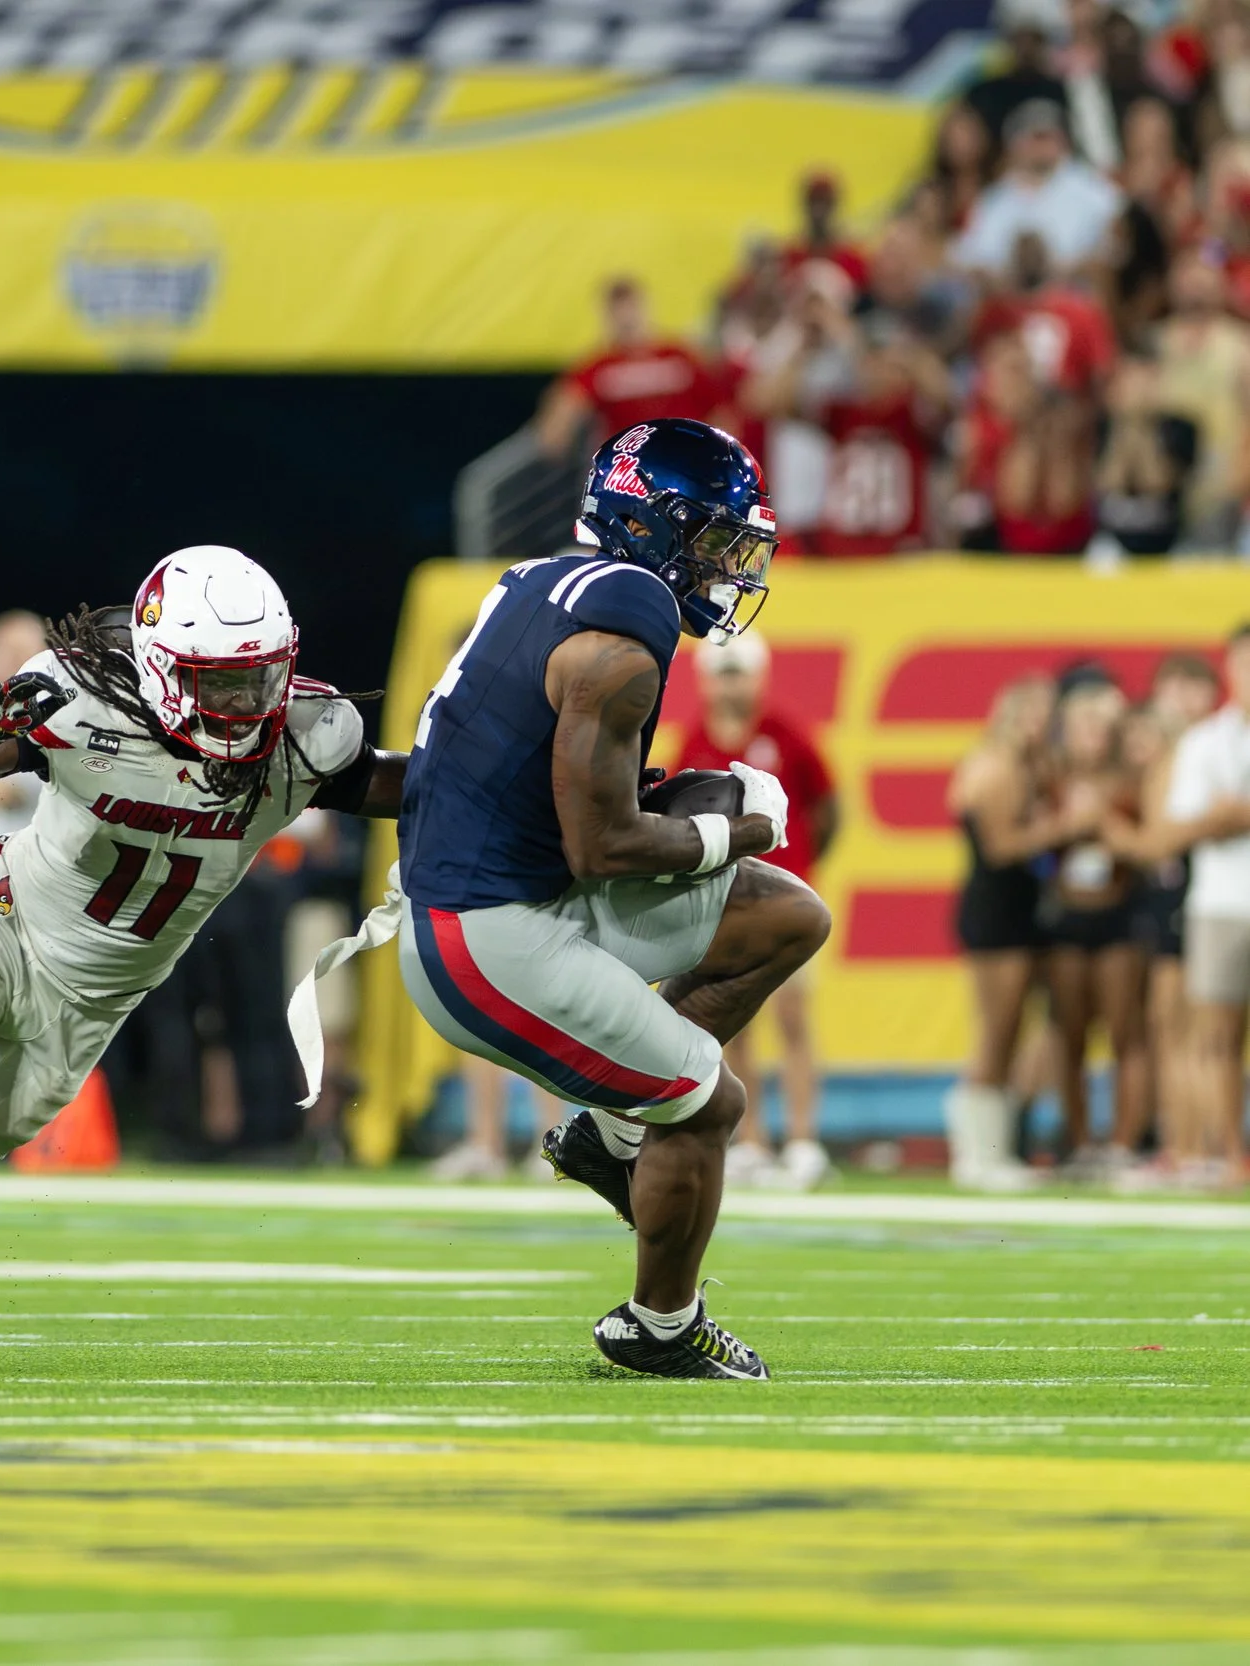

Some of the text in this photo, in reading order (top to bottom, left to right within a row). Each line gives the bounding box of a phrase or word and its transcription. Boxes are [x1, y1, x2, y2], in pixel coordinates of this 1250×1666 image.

[613, 424, 657, 453] Ole
[234, 640, 262, 653] ACC
[90, 736, 119, 749] L&N
[83, 839, 203, 941] 11
